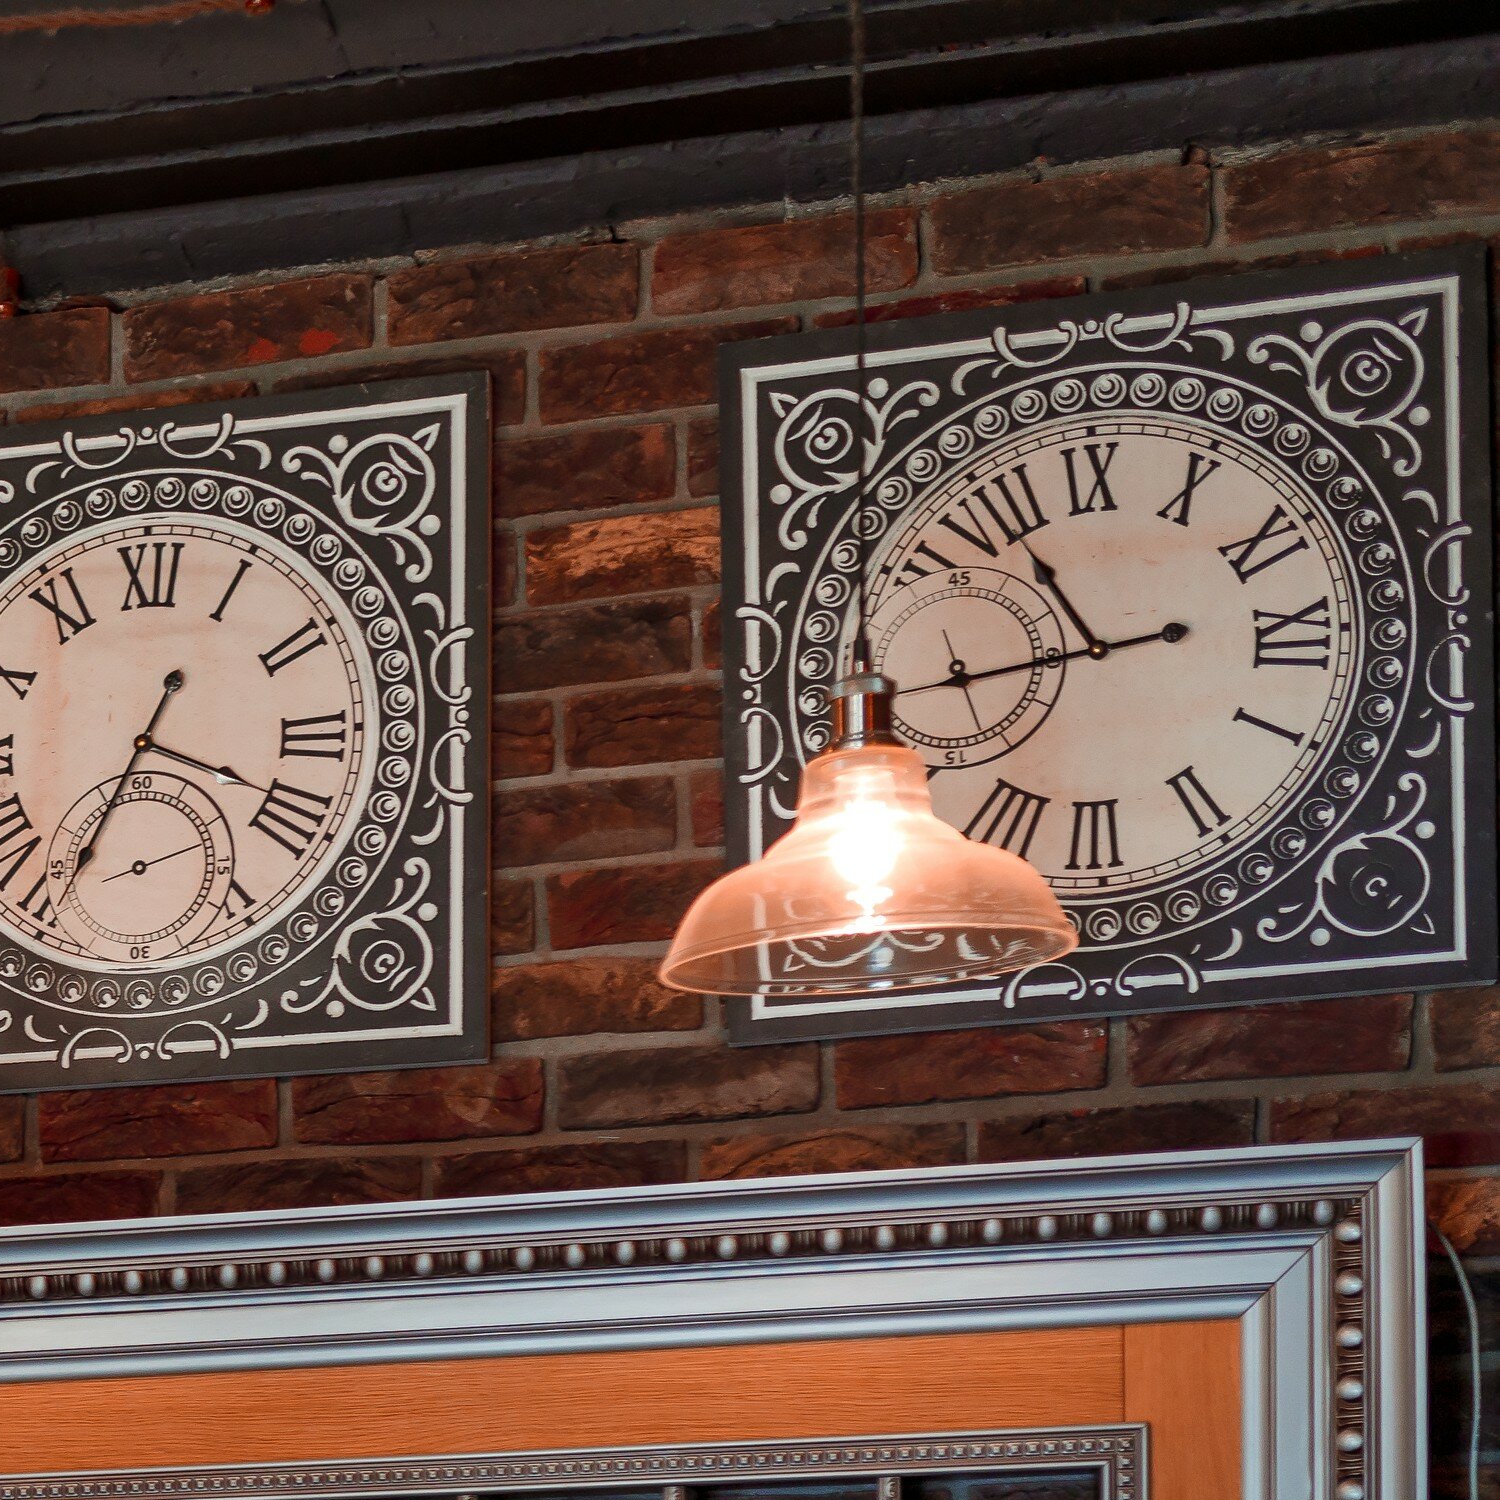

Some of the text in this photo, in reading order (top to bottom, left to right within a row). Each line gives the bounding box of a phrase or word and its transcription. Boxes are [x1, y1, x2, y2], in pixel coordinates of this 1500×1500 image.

[937, 463, 1050, 558] VIII
[1060, 442, 1119, 516] IX
[1156, 452, 1221, 526] X
[117, 541, 185, 612] XII
[948, 571, 971, 587] 45
[1217, 503, 1310, 584] XI
[28, 566, 98, 645] XI
[210, 558, 252, 622] I
[259, 617, 329, 678] II
[1252, 594, 1331, 671] XII
[280, 709, 347, 763] III
[944, 749, 967, 765] 15
[1232, 707, 1305, 749] I
[131, 776, 152, 790] 60
[1165, 763, 1232, 839] II
[249, 777, 335, 861] IIII
[960, 777, 1052, 862] IIII
[1064, 797, 1125, 870] III
[50, 859, 64, 880] 45
[216, 855, 231, 876] 15
[130, 945, 150, 960] 30
